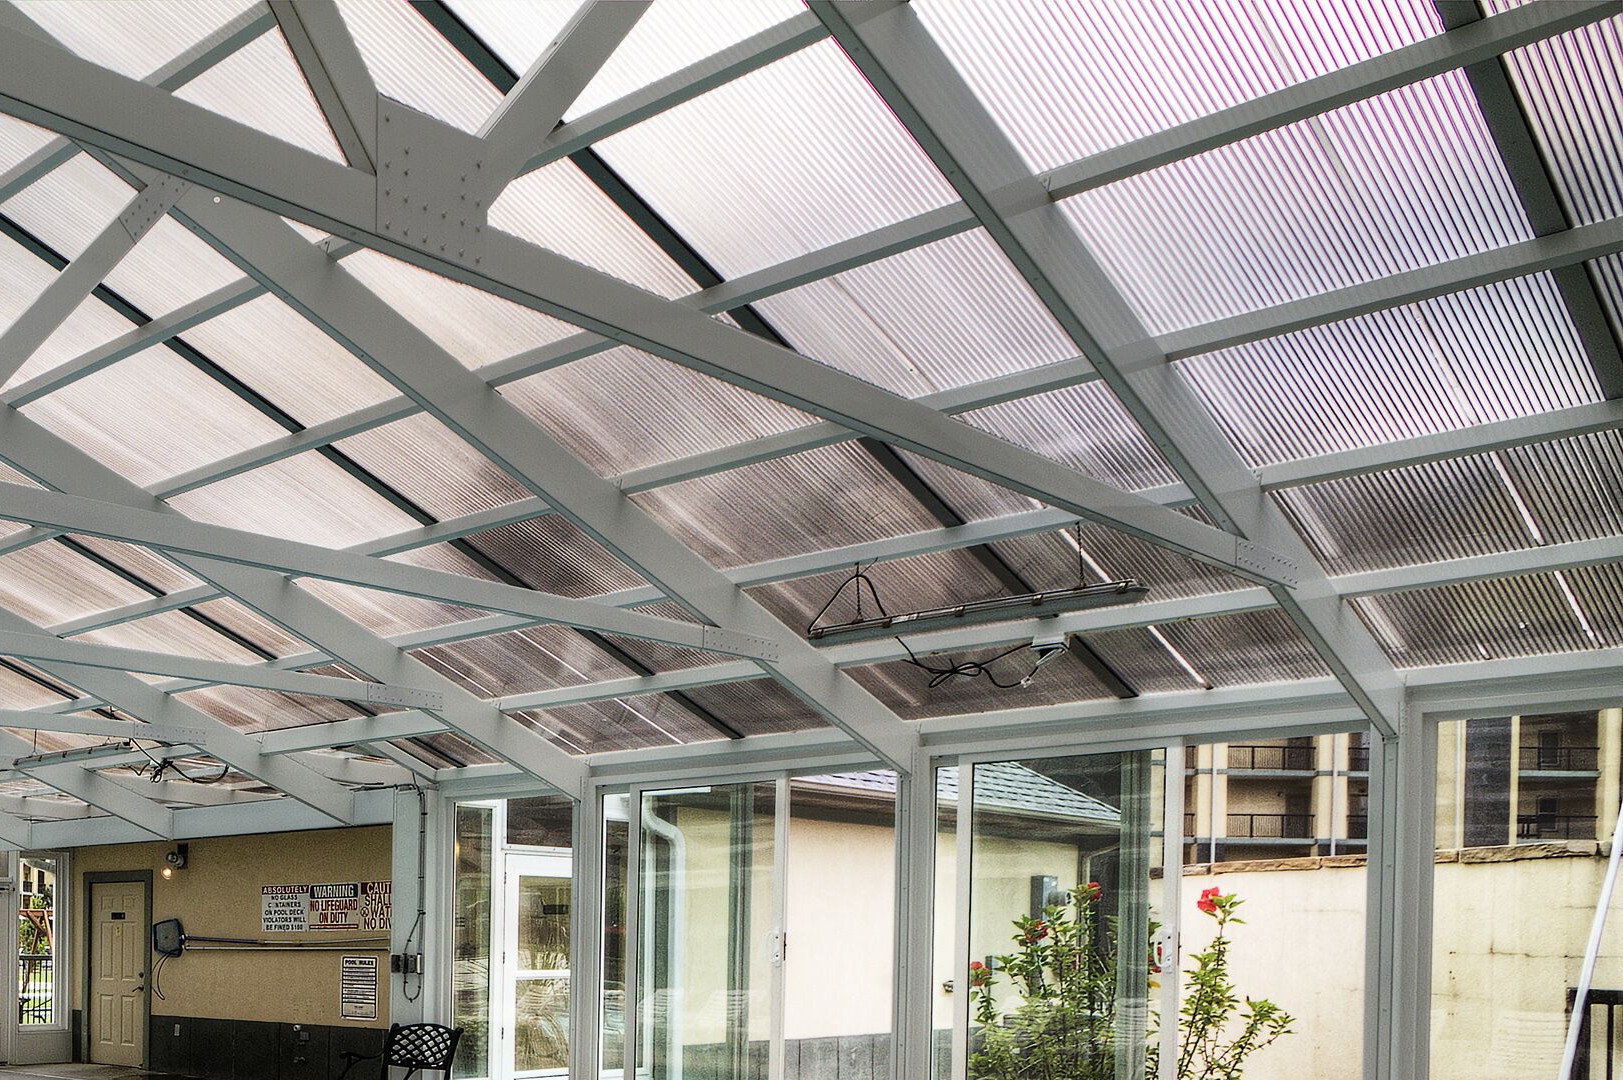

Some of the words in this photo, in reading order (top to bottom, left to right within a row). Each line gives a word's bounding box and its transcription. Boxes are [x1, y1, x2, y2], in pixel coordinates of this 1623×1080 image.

[263, 886, 308, 894] ABSOLUTELY
[313, 885, 354, 898] WARNING
[310, 900, 319, 912] NO
[321, 899, 357, 911] LIFEGUARD
[319, 912, 328, 923] ON
[330, 912, 348, 923] DUTY
[370, 906, 392, 918] WAT
[364, 918, 376, 930] NO
